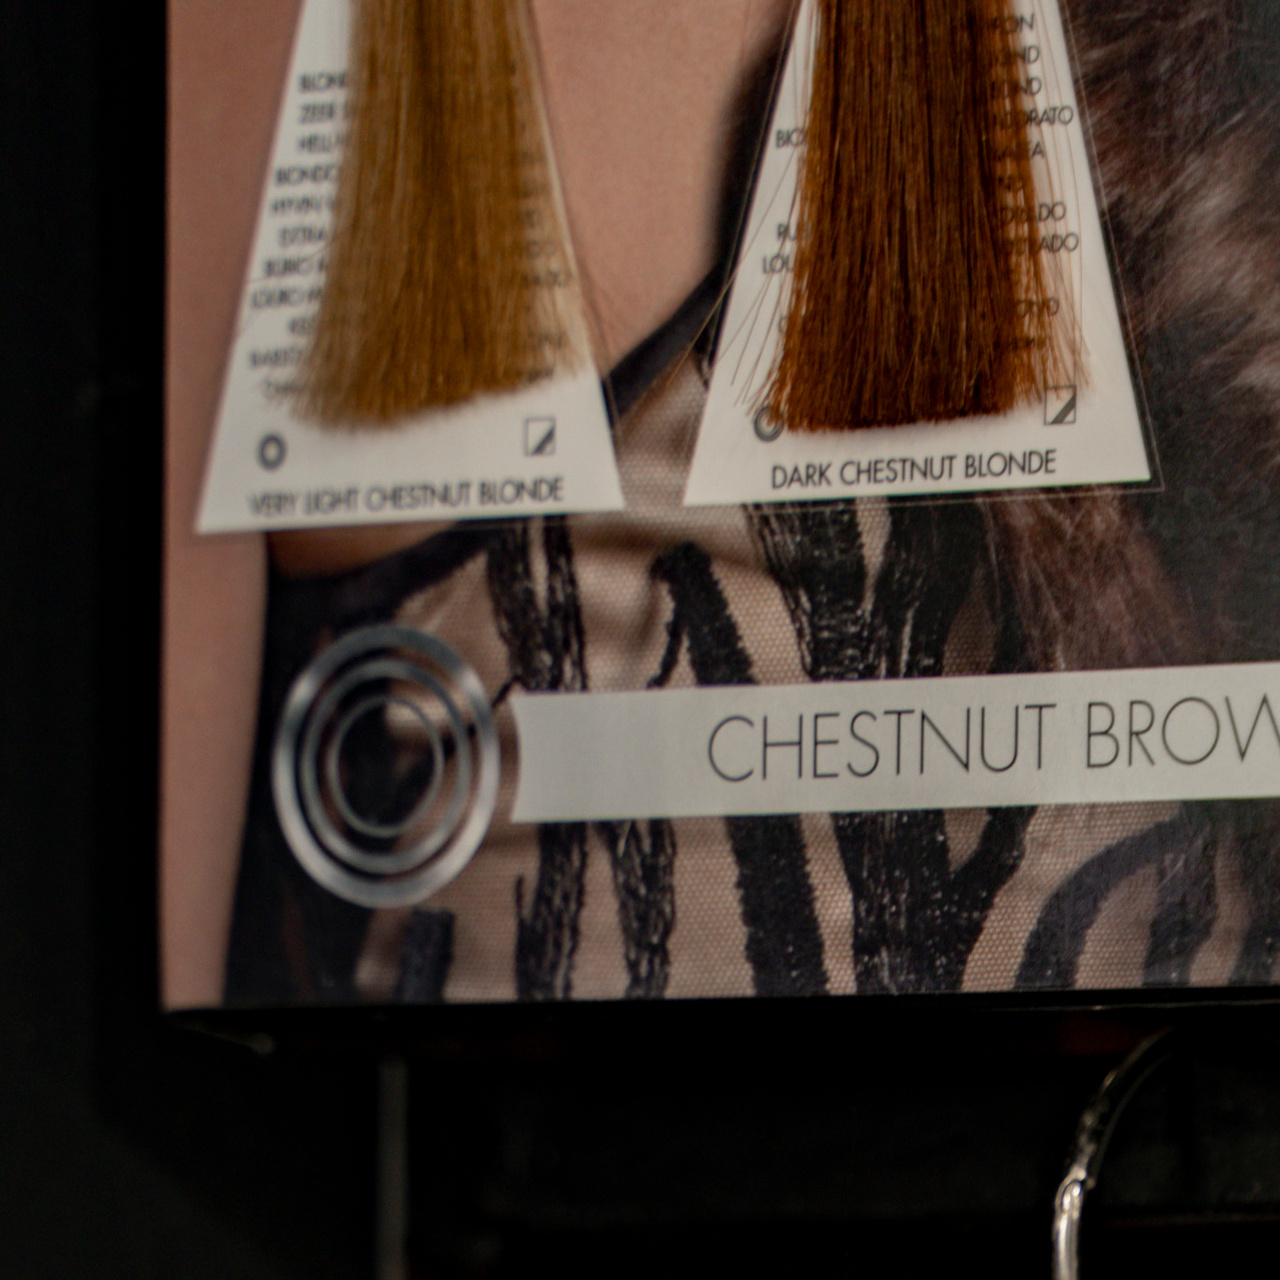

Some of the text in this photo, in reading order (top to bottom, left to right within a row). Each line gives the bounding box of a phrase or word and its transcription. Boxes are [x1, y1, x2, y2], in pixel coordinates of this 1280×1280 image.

[771, 449, 1057, 490] DARK CHESTNUT BLONDE
[251, 477, 564, 518] VERY LIGHT CHESTNUT BLONDE
[707, 703, 1057, 782] CHESTNUT
